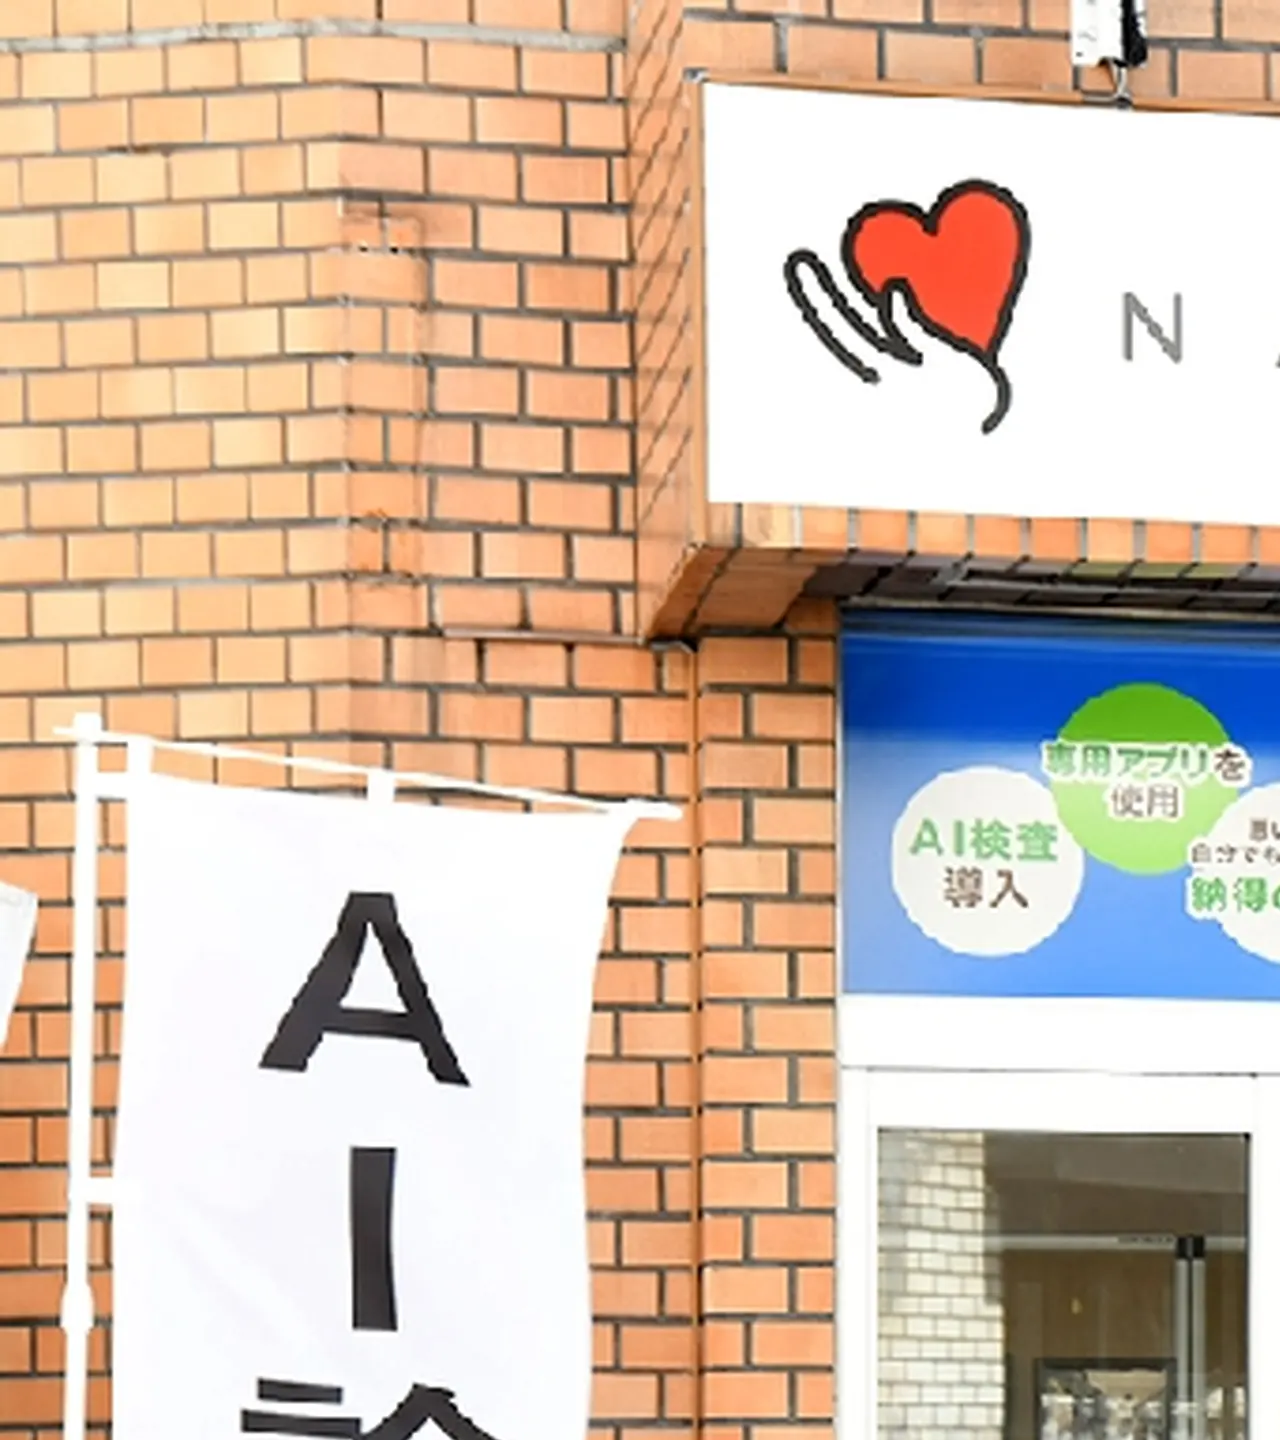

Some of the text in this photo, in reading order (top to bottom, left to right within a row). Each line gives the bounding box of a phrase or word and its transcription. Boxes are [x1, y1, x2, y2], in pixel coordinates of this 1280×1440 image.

[1046, 744, 1246, 780] 専用アプリを
[1111, 785, 1179, 817] 使用
[910, 816, 1059, 862] AI検査
[943, 866, 1029, 909] 導入
